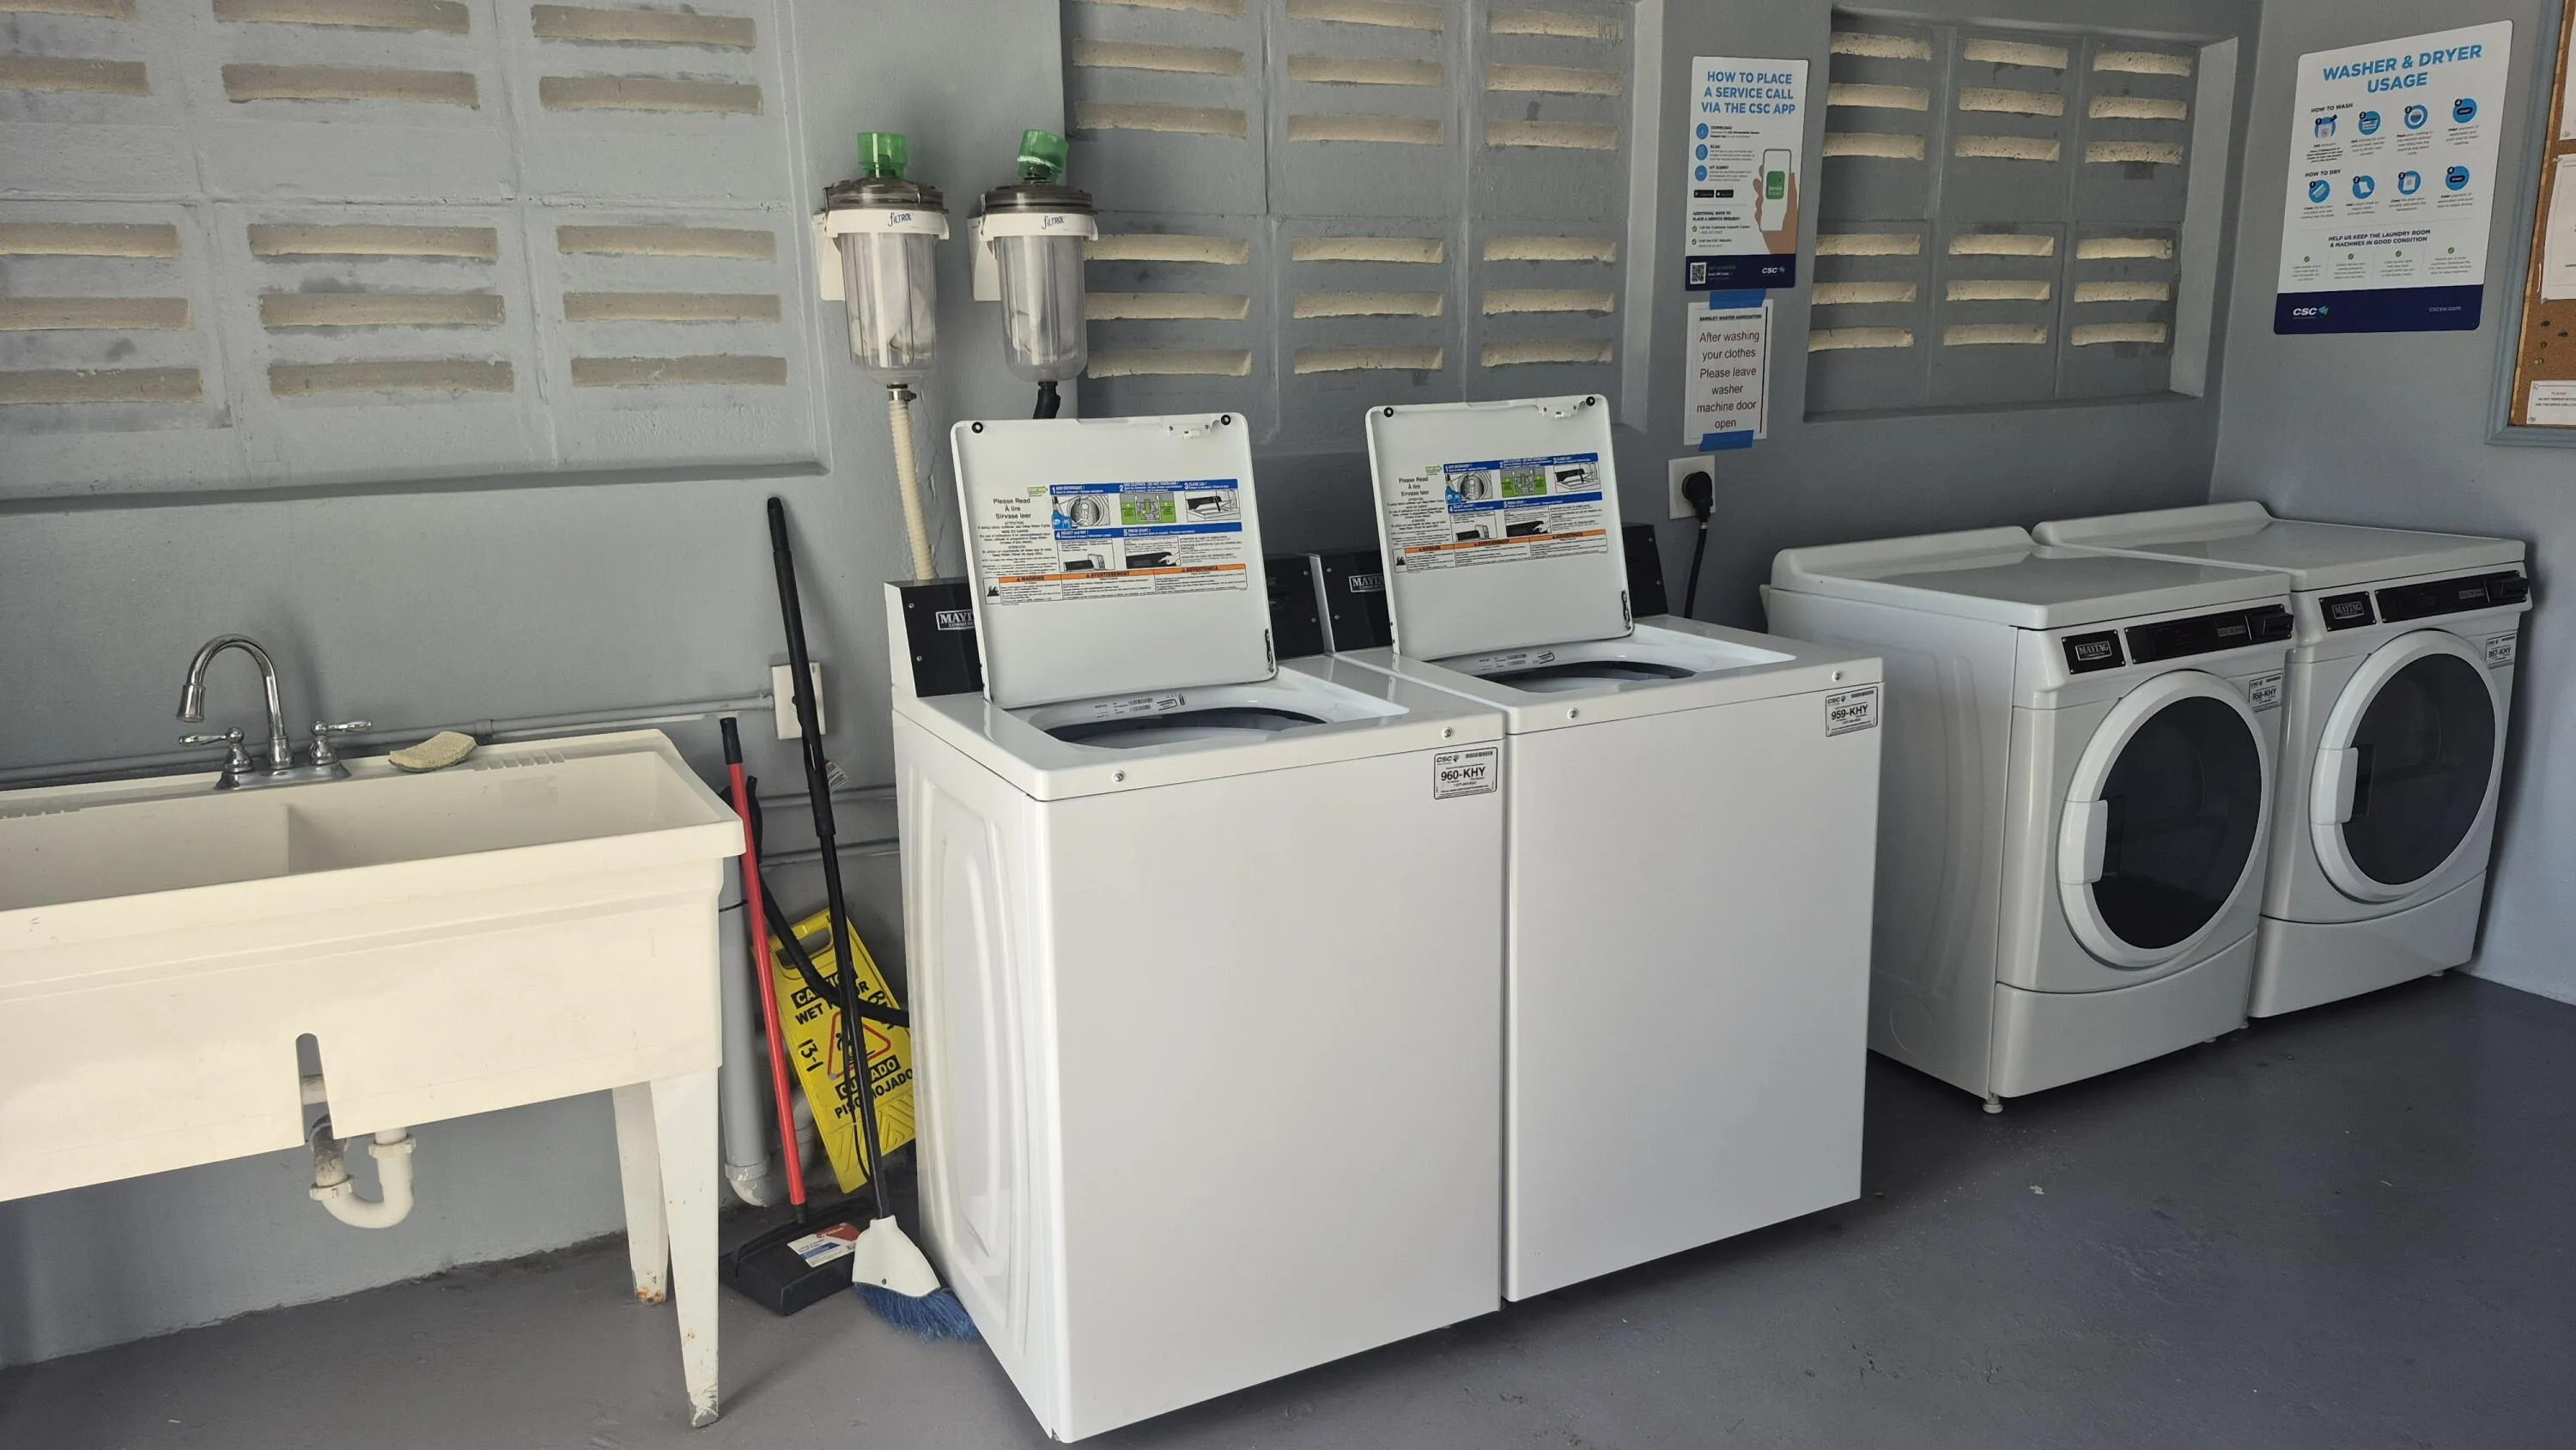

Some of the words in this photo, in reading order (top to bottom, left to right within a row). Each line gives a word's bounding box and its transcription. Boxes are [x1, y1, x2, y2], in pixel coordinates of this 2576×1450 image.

[2323, 58, 2397, 82] WASHER
[2402, 55, 2413, 70] &
[2419, 44, 2482, 67] DRYER
[1707, 71, 1736, 83] HOW
[1739, 72, 1753, 83] TO
[1757, 73, 1792, 84] PLACE
[2366, 72, 2428, 94] USAGE
[1704, 87, 1712, 97] A
[1716, 87, 1763, 99] SERVICE
[1765, 88, 1794, 100] CALL
[1701, 102, 1721, 113] VIA
[1724, 102, 1746, 113] THE
[1748, 103, 1771, 114] CSC
[1773, 104, 1795, 114] APP
[2293, 307, 2318, 316] CSC
[1699, 331, 1722, 343] After
[1724, 330, 1759, 343] washing
[1702, 351, 1722, 363] your
[1725, 348, 1756, 359] clothes
[1700, 368, 1730, 379] Please
[1732, 367, 1757, 377] leave
[1711, 384, 1744, 395] washer
[1697, 402, 1734, 413] machine
[1736, 400, 1757, 410] door
[1714, 419, 1737, 430] open
[2335, 604, 2361, 612] MAYTAG
[2078, 643, 2109, 655] MAYTAG
[1831, 704, 1868, 720] 959-KHY
[1441, 766, 1485, 781] 960-KHY
[795, 1003, 823, 1025] WET
[839, 1059, 897, 1097] CUADO
[871, 1068, 913, 1100] OJADO
